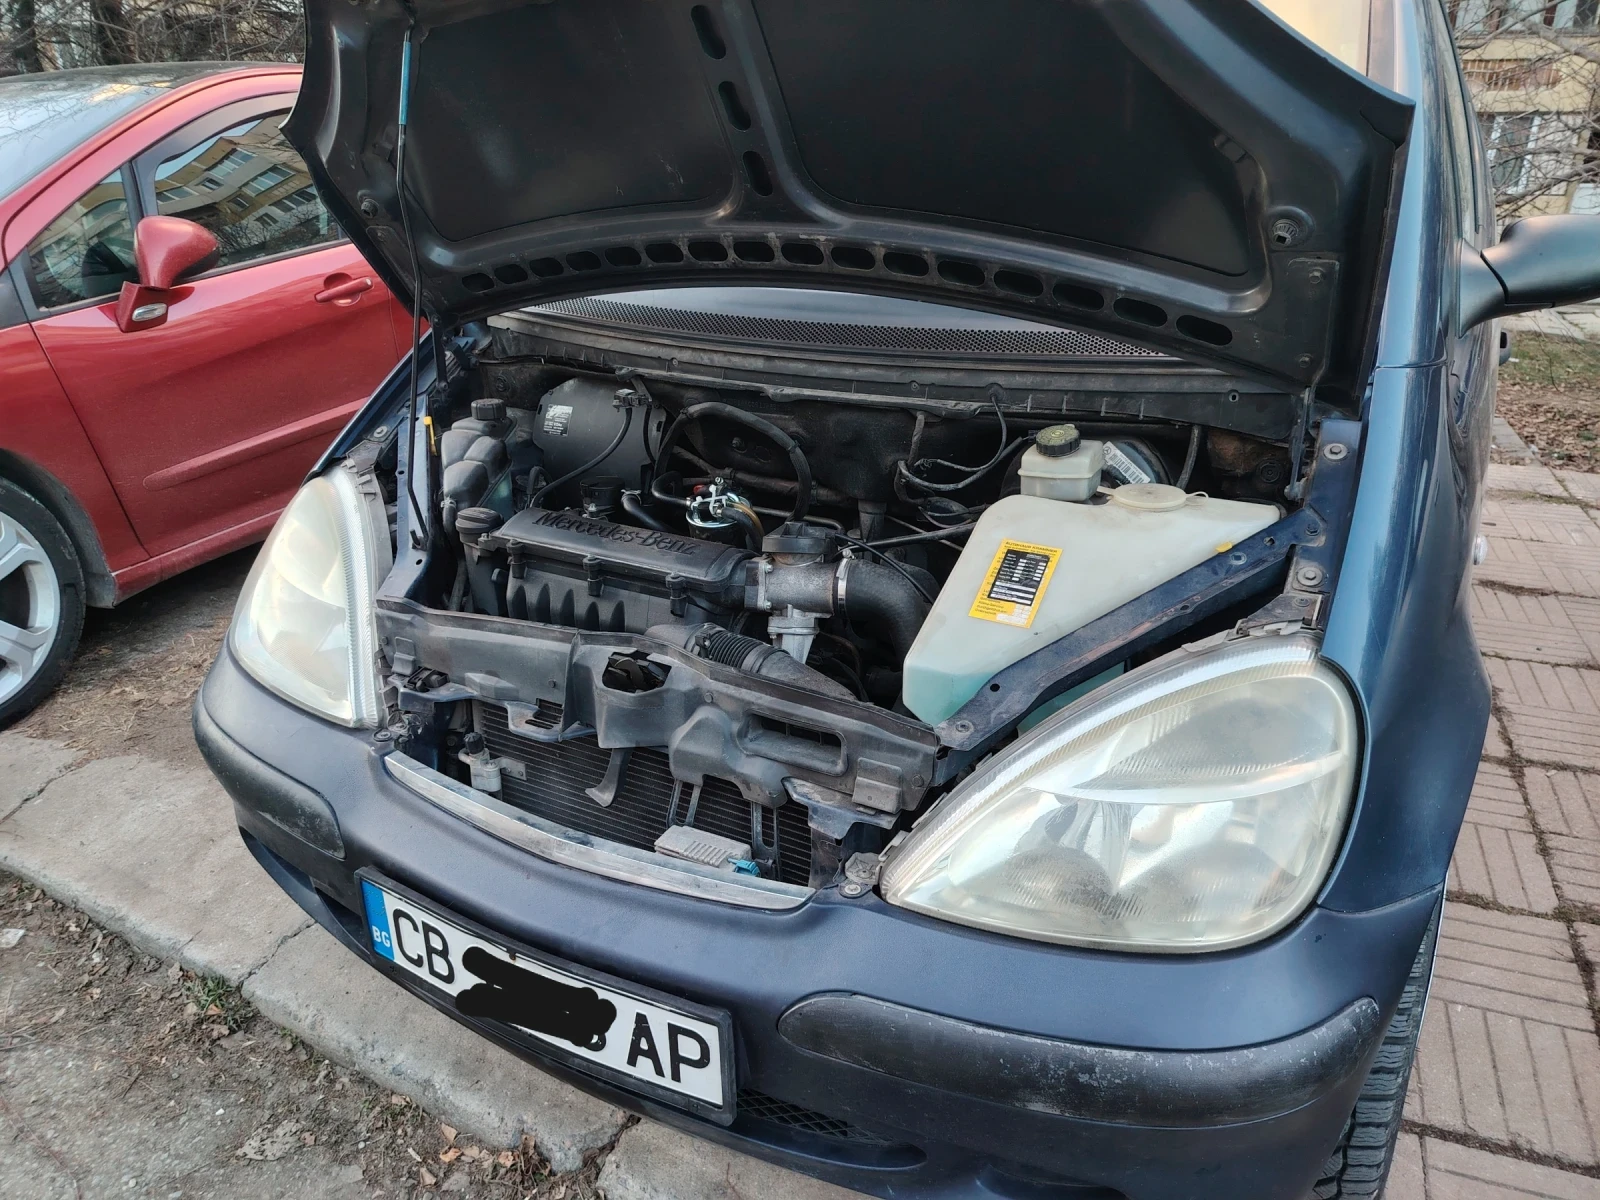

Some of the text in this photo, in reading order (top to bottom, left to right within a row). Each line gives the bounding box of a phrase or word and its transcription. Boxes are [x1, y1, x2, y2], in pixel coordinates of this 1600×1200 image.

[532, 511, 699, 555] Mercedes-Benz
[372, 925, 391, 948] BG
[393, 908, 711, 1083] CB AP
